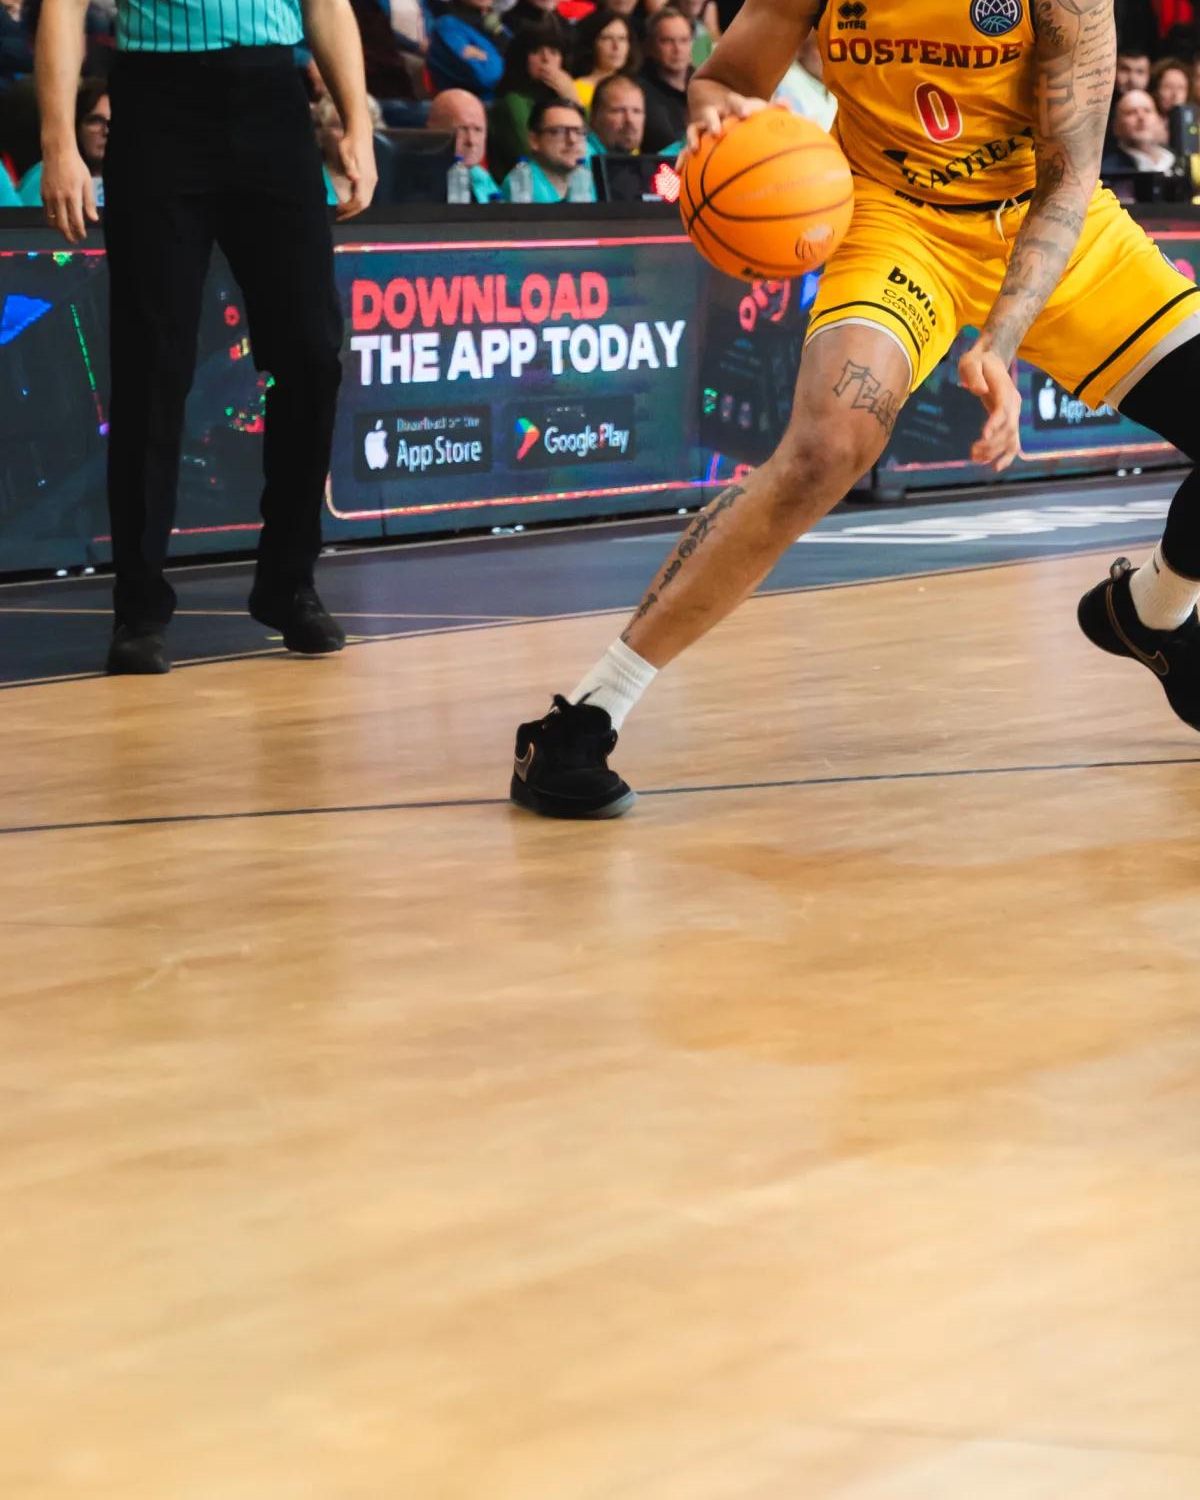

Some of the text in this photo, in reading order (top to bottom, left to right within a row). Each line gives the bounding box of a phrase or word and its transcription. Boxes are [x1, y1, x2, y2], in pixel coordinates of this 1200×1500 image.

[827, 37, 1025, 69] OOSTENDE
[914, 82, 963, 143] 0
[351, 271, 609, 331] DOWNLOAD
[887, 265, 937, 327] bwin
[350, 319, 686, 386] THE APP TODAY
[396, 435, 483, 473] App Store
[544, 422, 630, 457] Google Play
